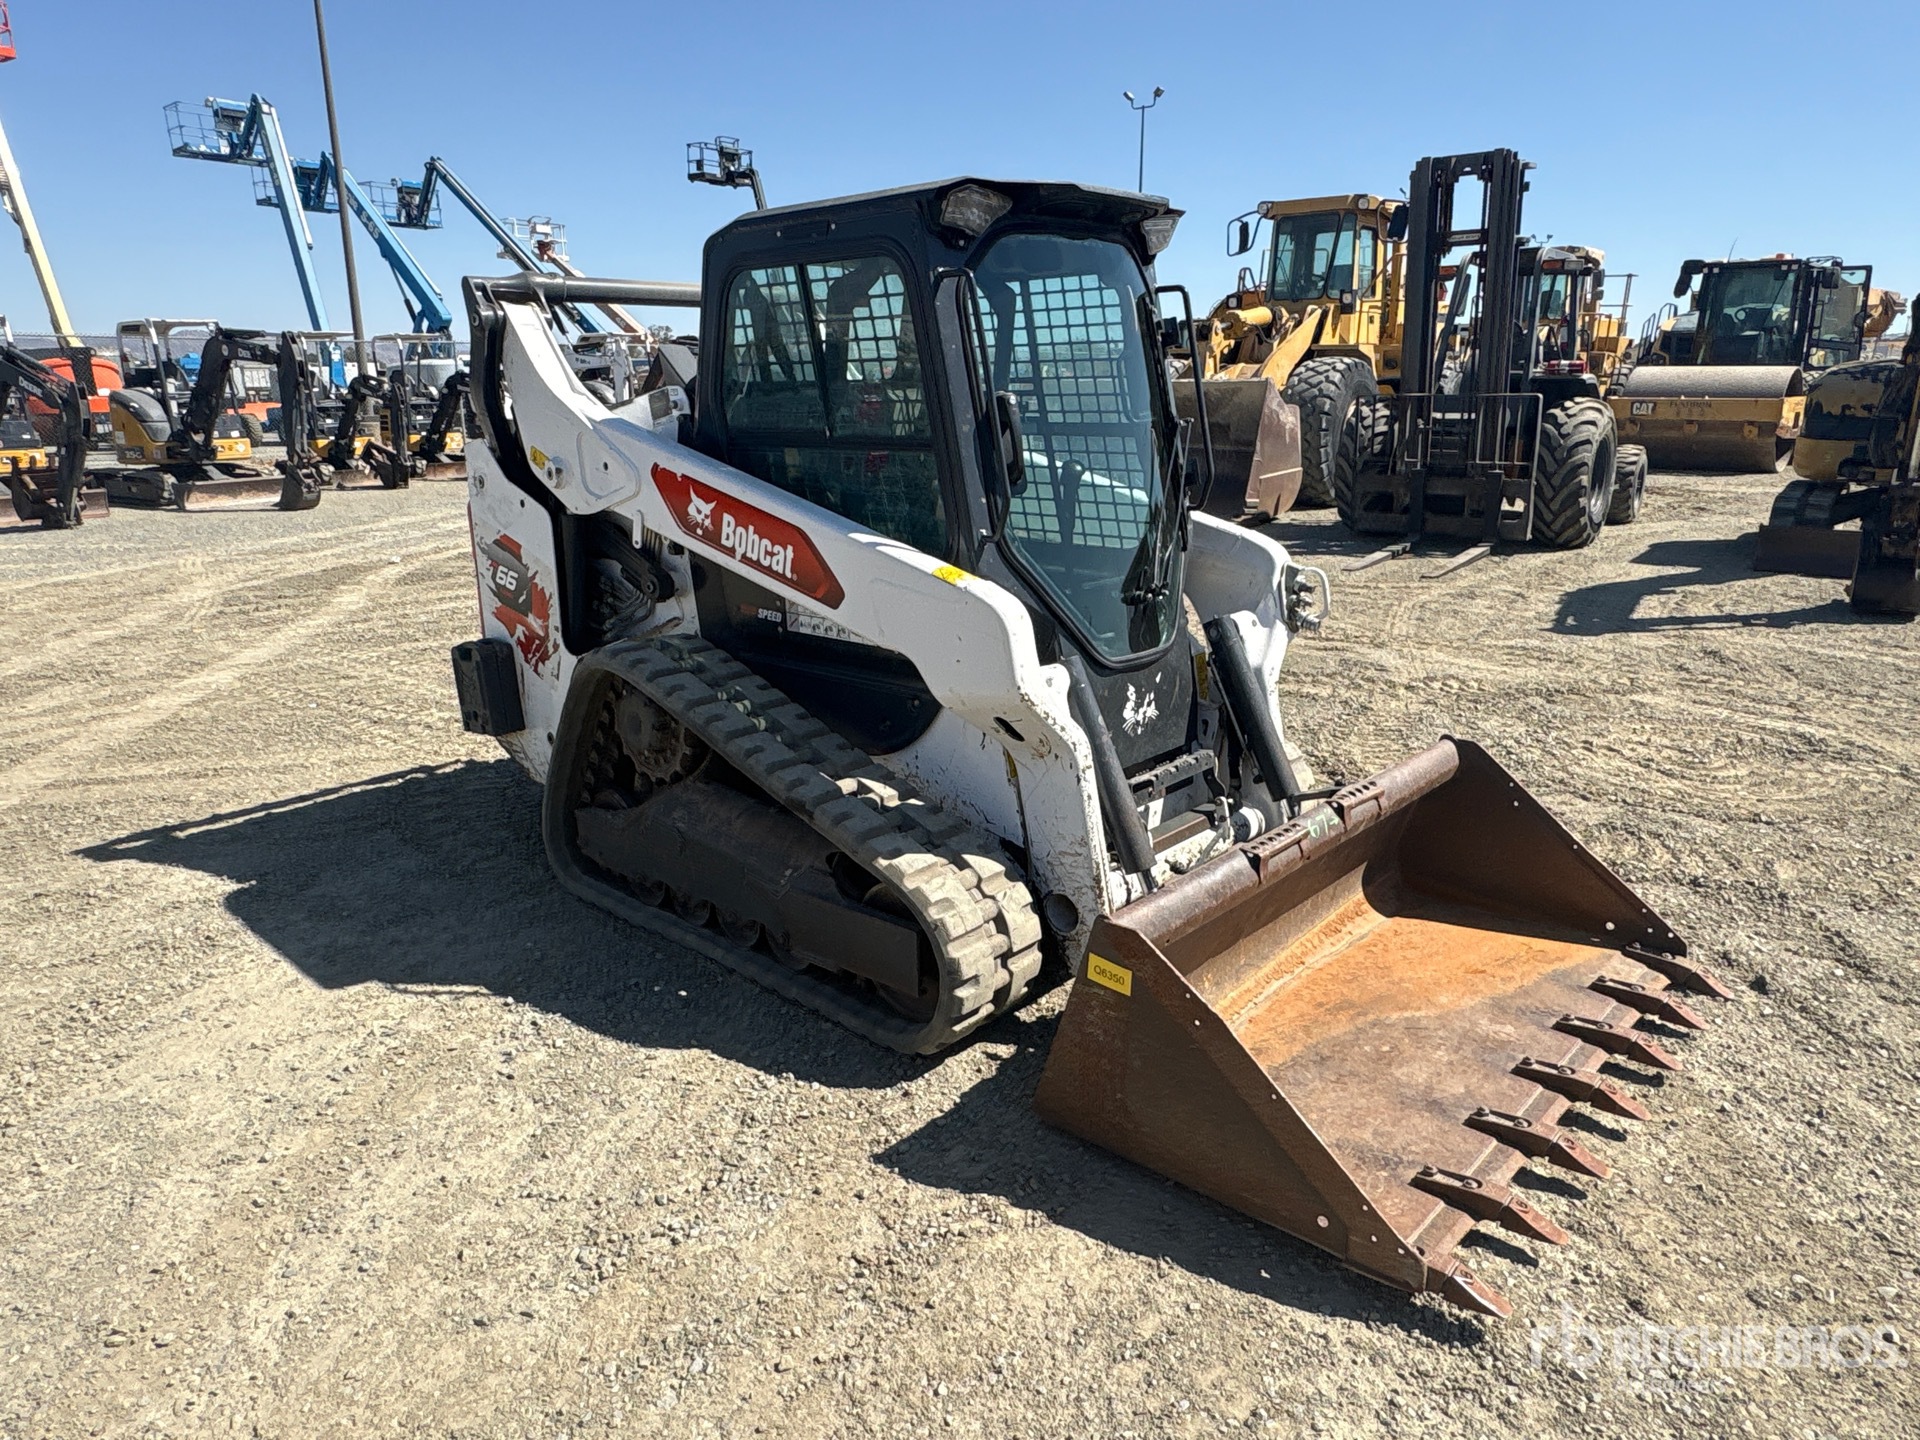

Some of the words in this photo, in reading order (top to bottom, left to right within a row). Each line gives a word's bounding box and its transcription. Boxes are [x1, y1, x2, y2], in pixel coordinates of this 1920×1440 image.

[1632, 402, 1654, 415] CAT
[720, 512, 794, 579] Bobcat
[757, 608, 782, 622] SPEED
[1093, 964, 1125, 986] Q6350
